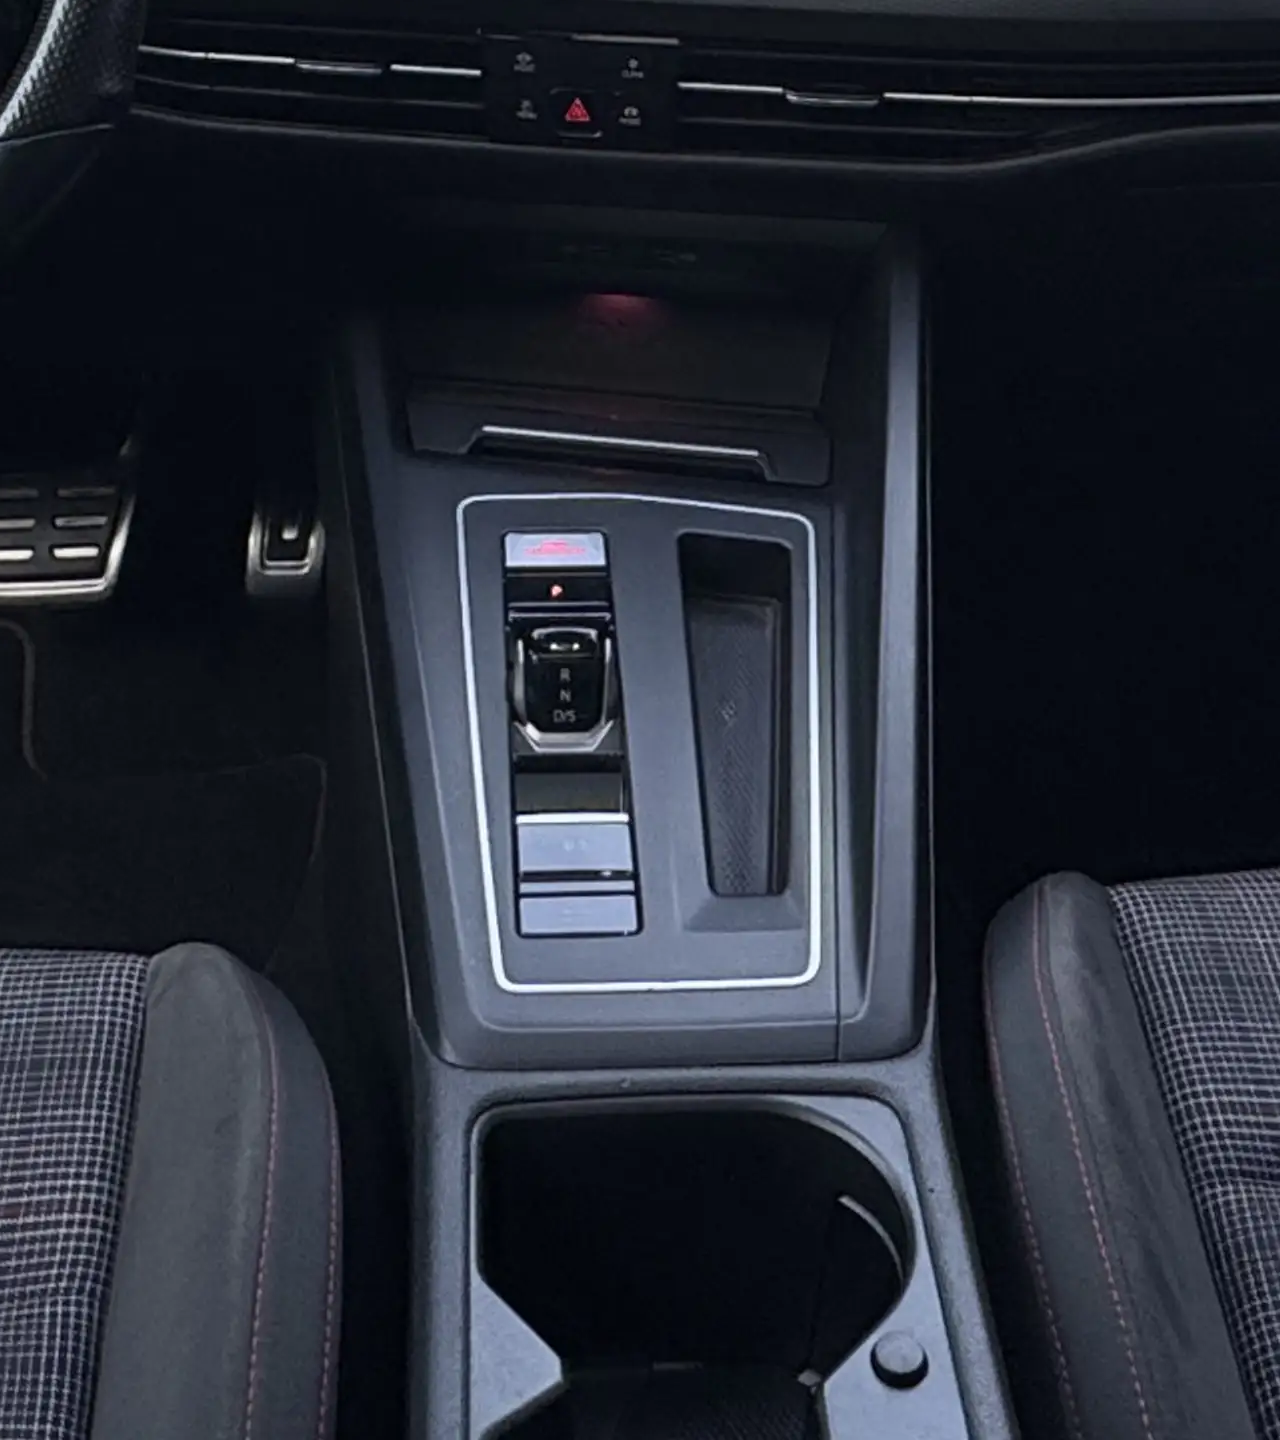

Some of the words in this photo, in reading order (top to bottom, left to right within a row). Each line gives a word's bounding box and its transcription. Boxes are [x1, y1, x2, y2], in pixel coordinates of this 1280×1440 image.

[559, 667, 571, 682] R
[559, 689, 572, 702] N
[552, 709, 576, 723] D/S
